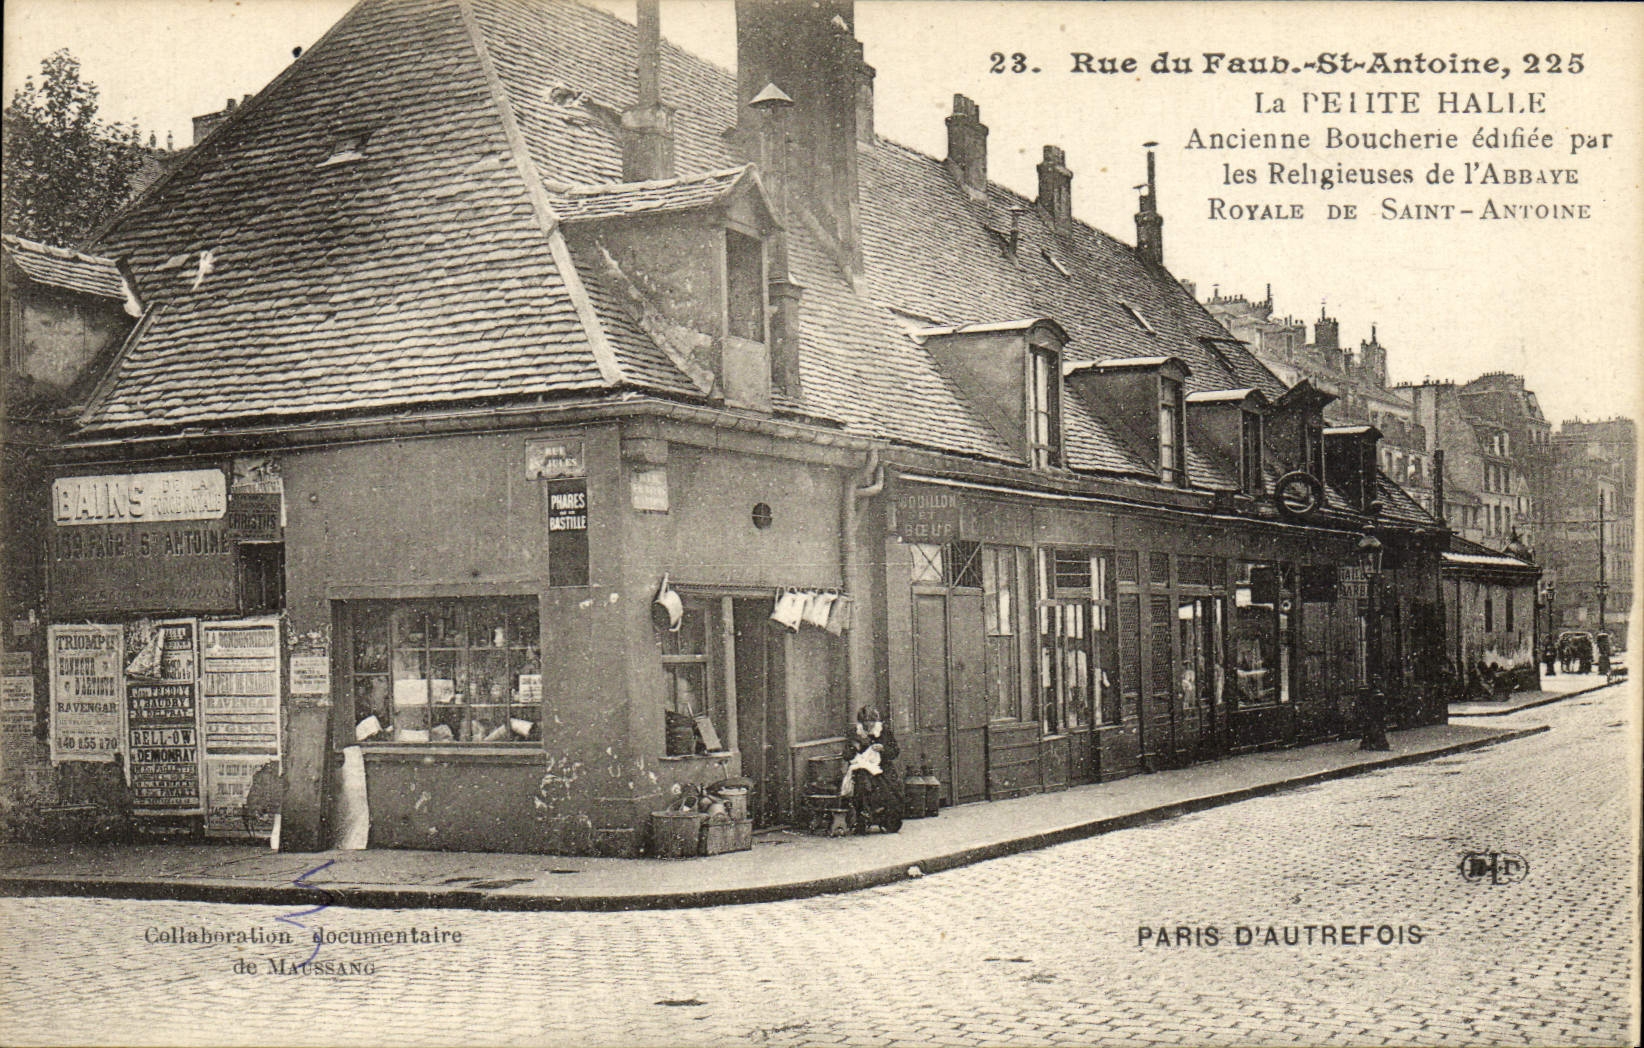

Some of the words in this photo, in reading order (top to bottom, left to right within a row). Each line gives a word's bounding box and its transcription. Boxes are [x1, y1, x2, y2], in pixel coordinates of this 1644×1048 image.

[55, 482, 145, 522] BAINS
[551, 493, 585, 510] PHARES
[549, 515, 587, 531] BASTILLE
[57, 702, 117, 714] RAVENGAR
